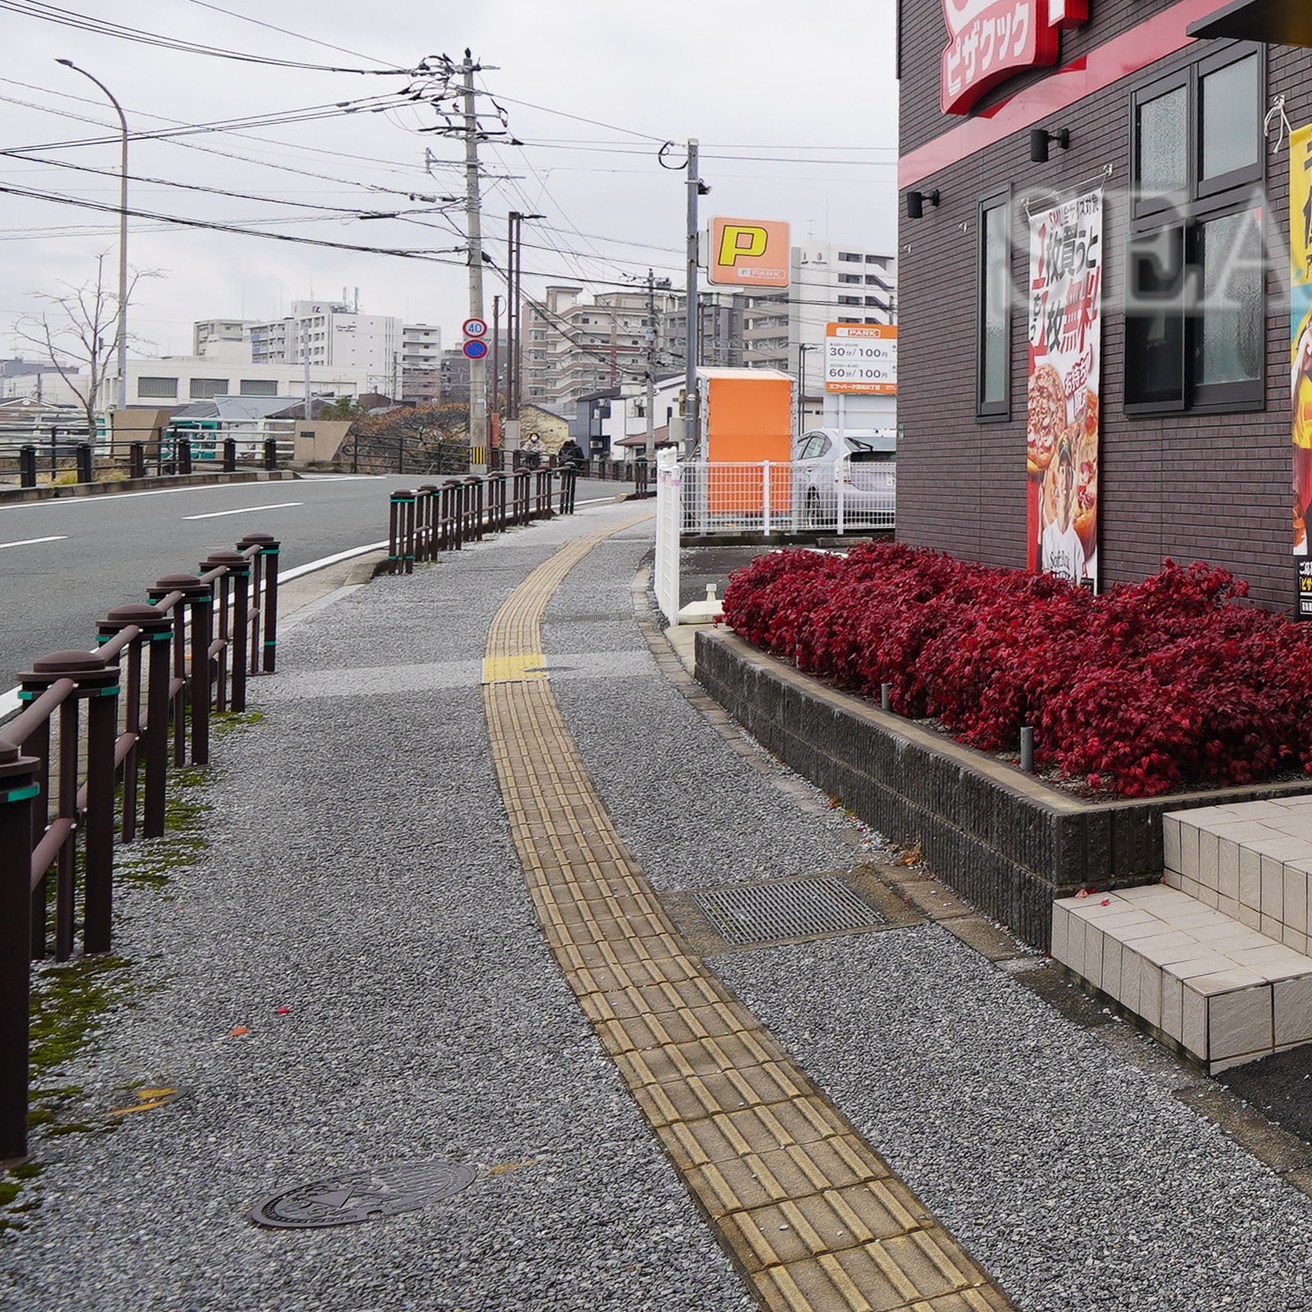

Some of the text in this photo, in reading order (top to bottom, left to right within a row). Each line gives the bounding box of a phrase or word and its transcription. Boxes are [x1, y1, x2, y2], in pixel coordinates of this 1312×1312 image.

[945, 1, 1030, 96] ピザクック
[718, 224, 768, 266] P
[468, 323, 482, 334] 40
